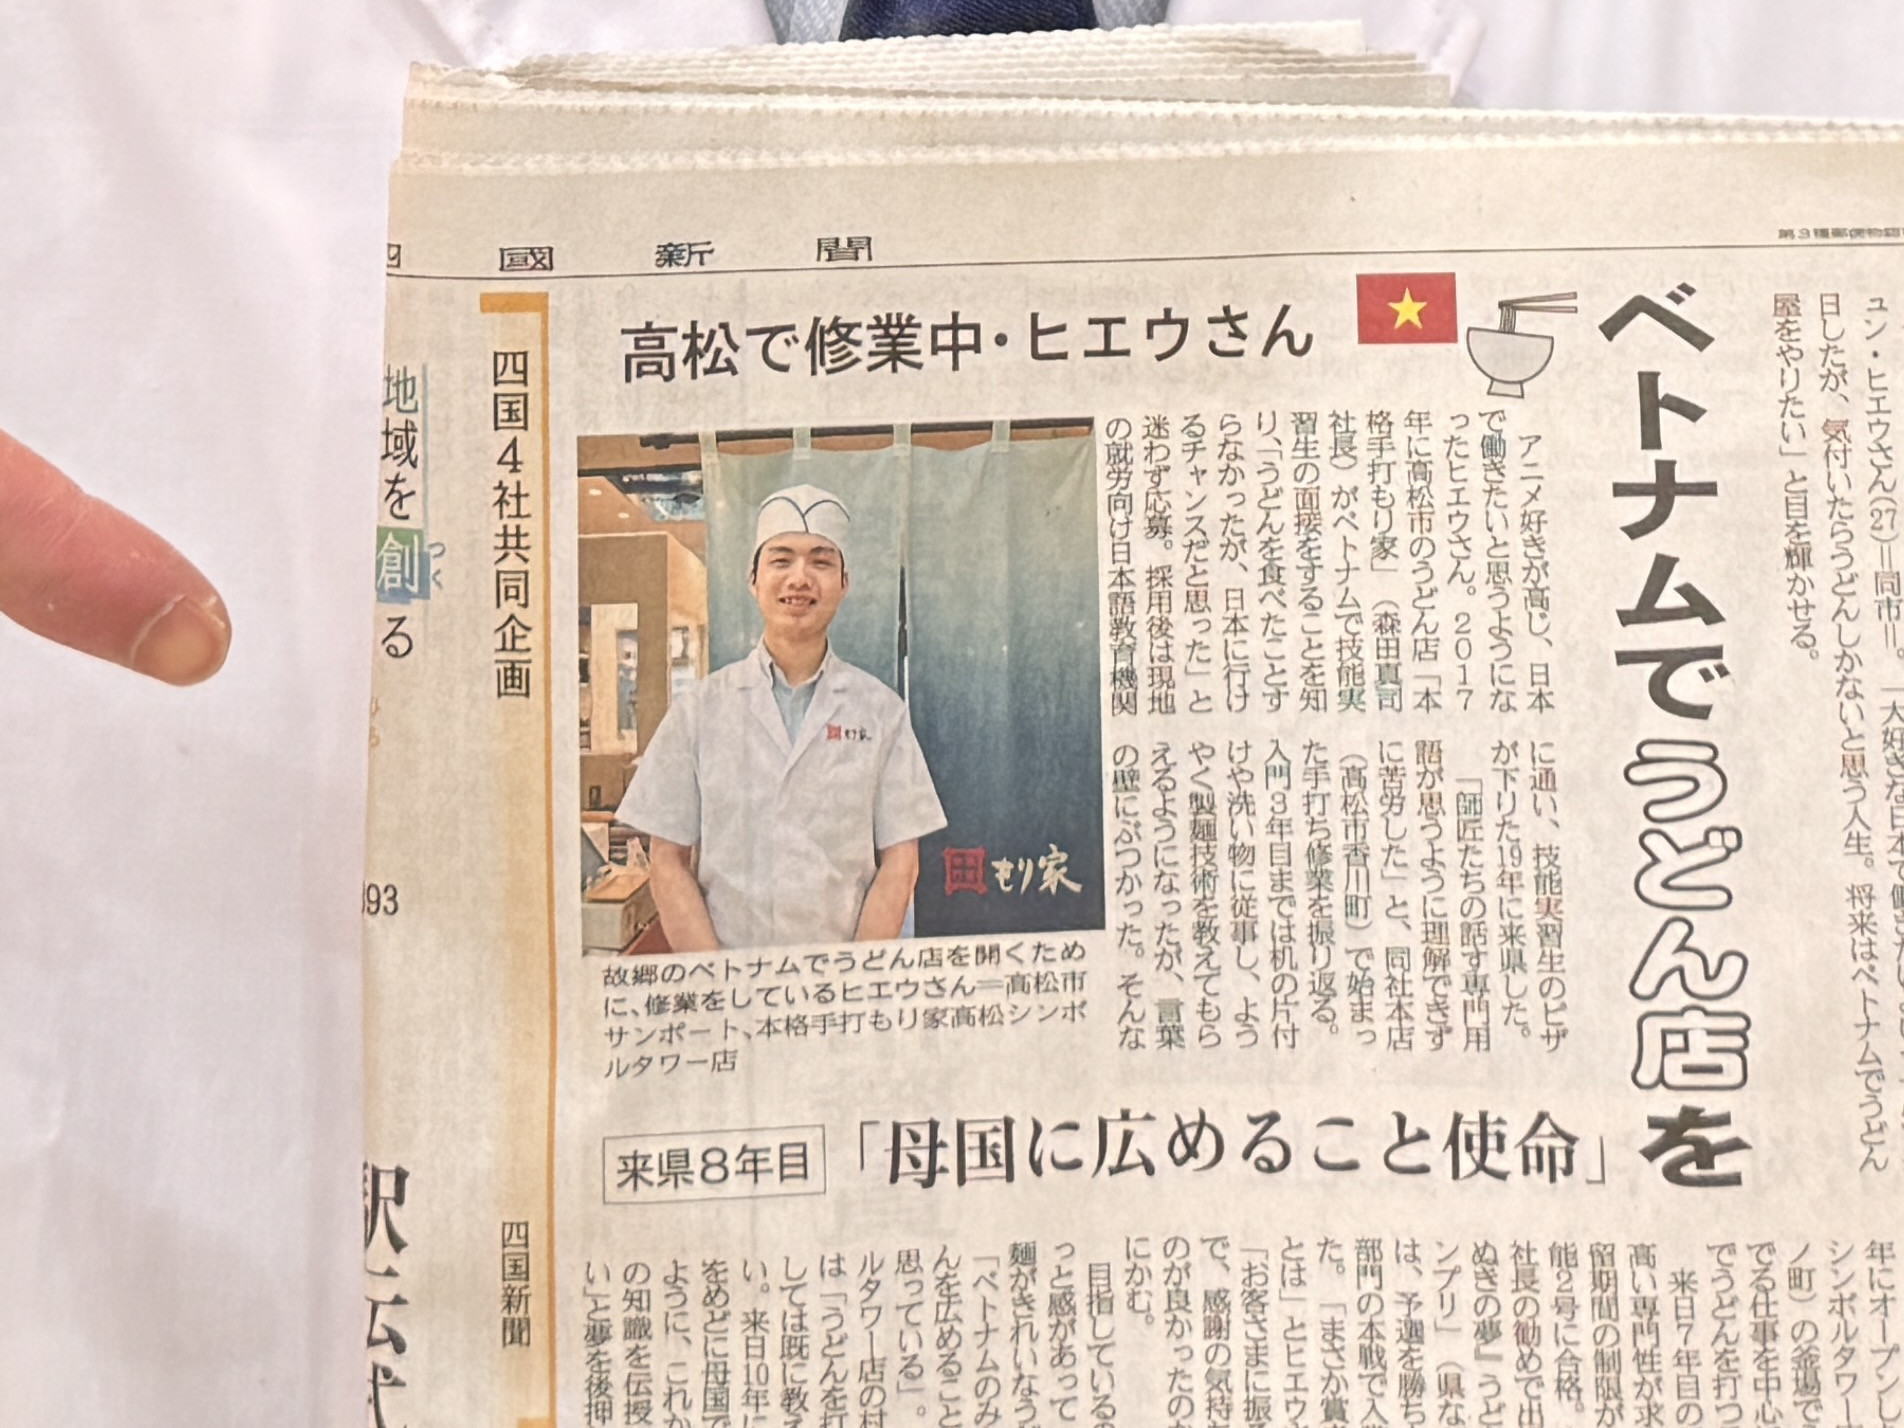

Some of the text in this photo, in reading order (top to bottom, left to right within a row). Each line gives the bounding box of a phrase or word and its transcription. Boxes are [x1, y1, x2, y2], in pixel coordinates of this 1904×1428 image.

[620, 303, 1314, 385] 高松で修業中・ヒエウさん
[377, 363, 420, 660] 地域を創る
[492, 351, 532, 700] 四国4社共同企画
[1598, 282, 1753, 1187] ベトナムでうどん店を
[362, 881, 400, 916] 93
[602, 940, 1086, 986] 故郷のベトナムでうどん店を開くため
[604, 1049, 738, 1080] ルタワー店
[859, 1106, 1605, 1188] 「母国に広めること使命」
[615, 1141, 811, 1192] 来県8年目
[501, 1221, 531, 1347] 四国新聞
[1009, 1241, 1041, 1428] 麺がきれいなう
[1086, 1262, 1116, 1428] 目指している
[1163, 1236, 1194, 1428] のが良かったの
[1200, 1236, 1233, 1428] で、感謝の気持
[1241, 1248, 1272, 1428] 「お客さまに振
[1279, 1236, 1309, 1428] とは」とヒエウ
[1317, 1236, 1349, 1428] た。「まさか賞
[1355, 1238, 1389, 1428] 部門の本戦で入
[1828, 1241, 1863, 1428] シンボルタワー
[1865, 1240, 1901, 1428] 年にオープンし
